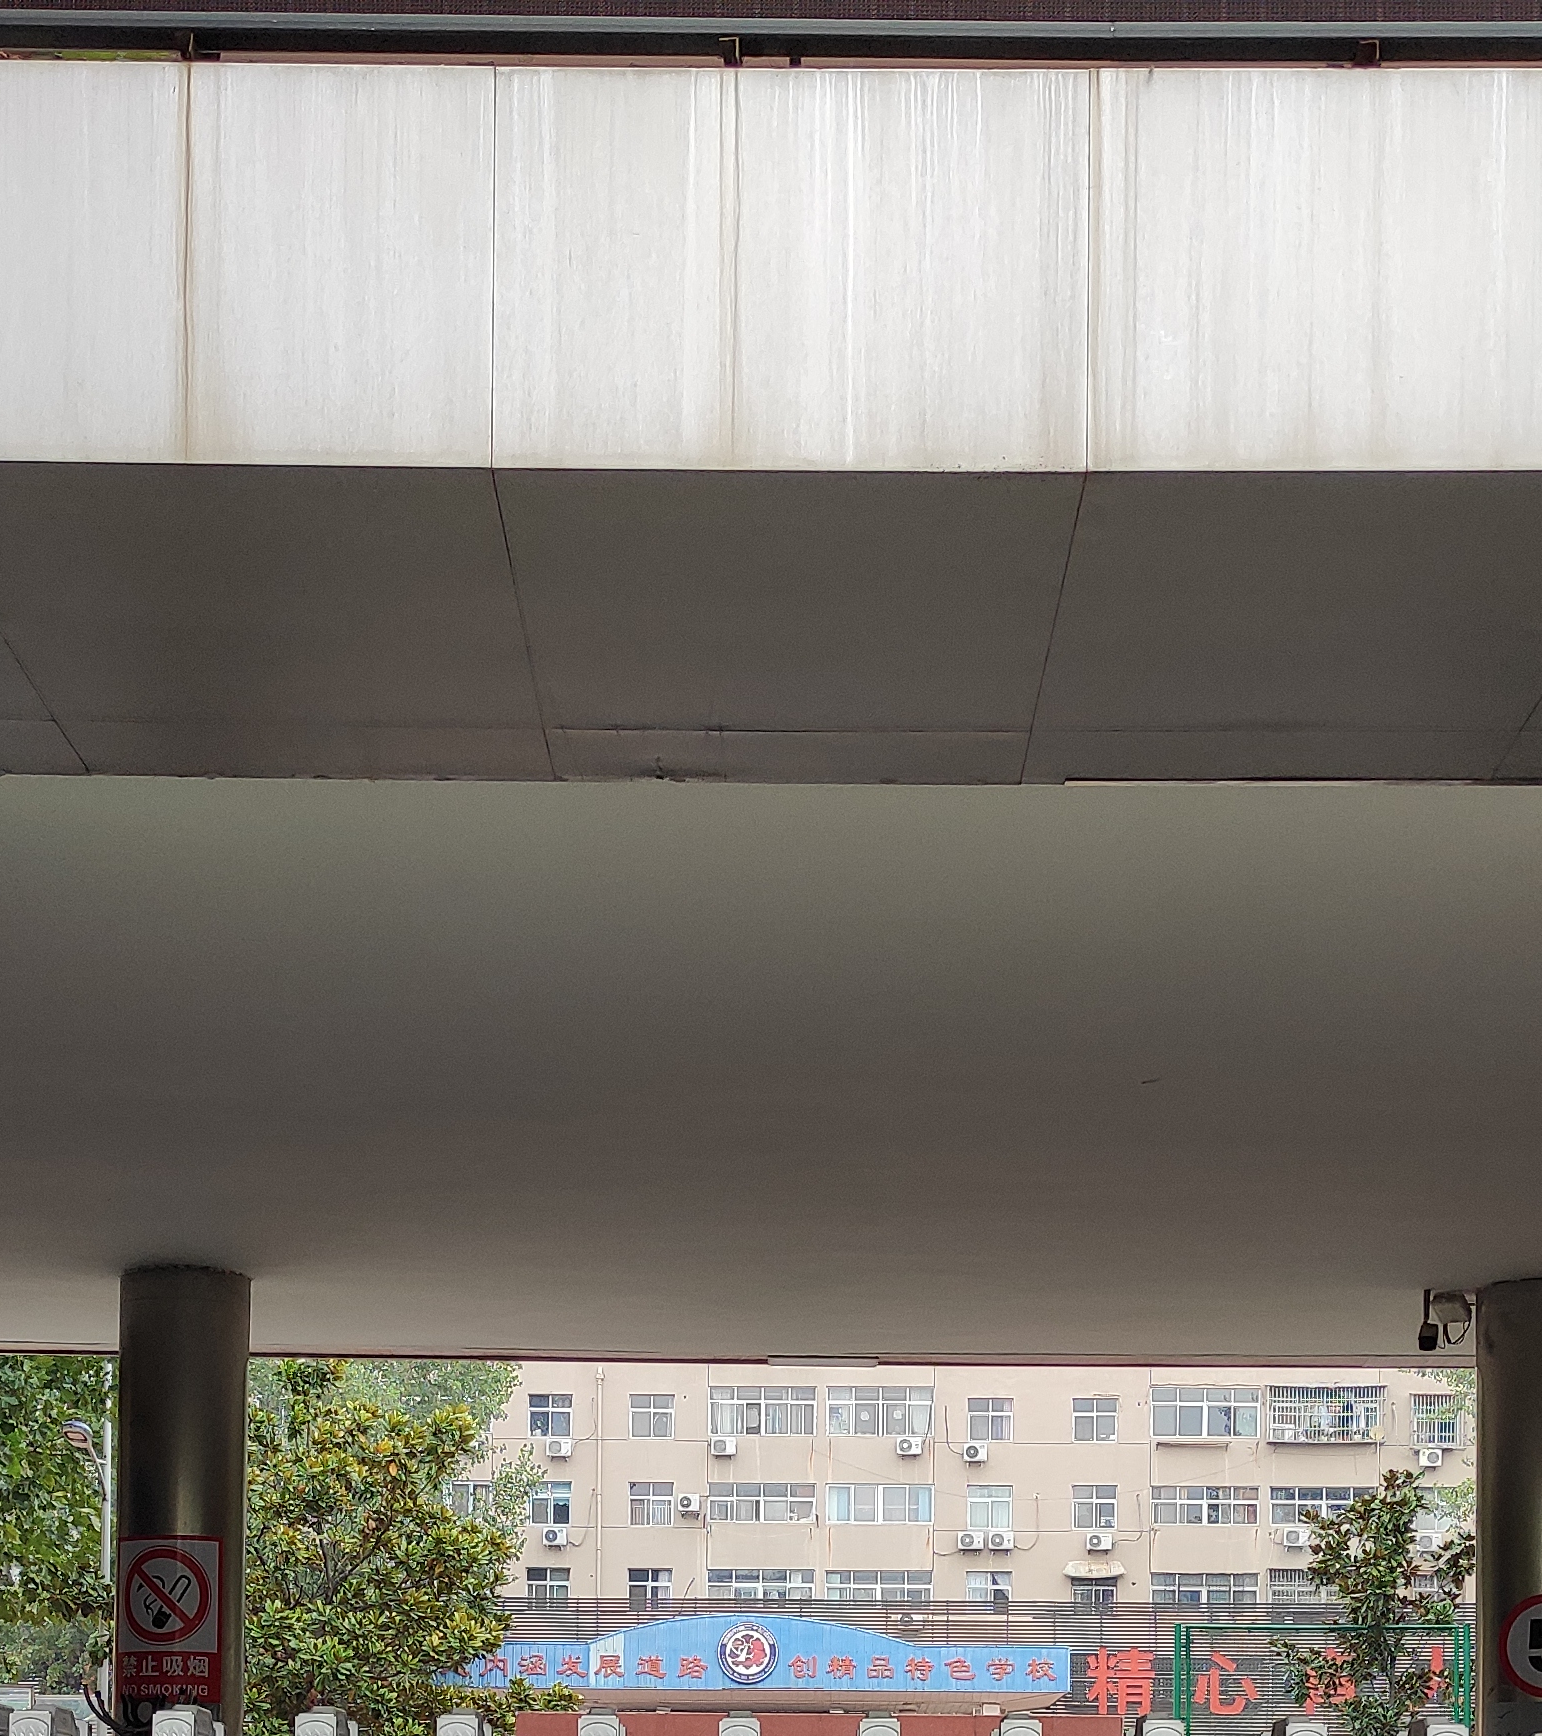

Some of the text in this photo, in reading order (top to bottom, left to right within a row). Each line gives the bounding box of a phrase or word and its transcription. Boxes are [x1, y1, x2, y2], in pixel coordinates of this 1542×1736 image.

[122, 1655, 209, 1677] 禁止吸烟
[789, 1655, 1057, 1682] 创精品特色学校
